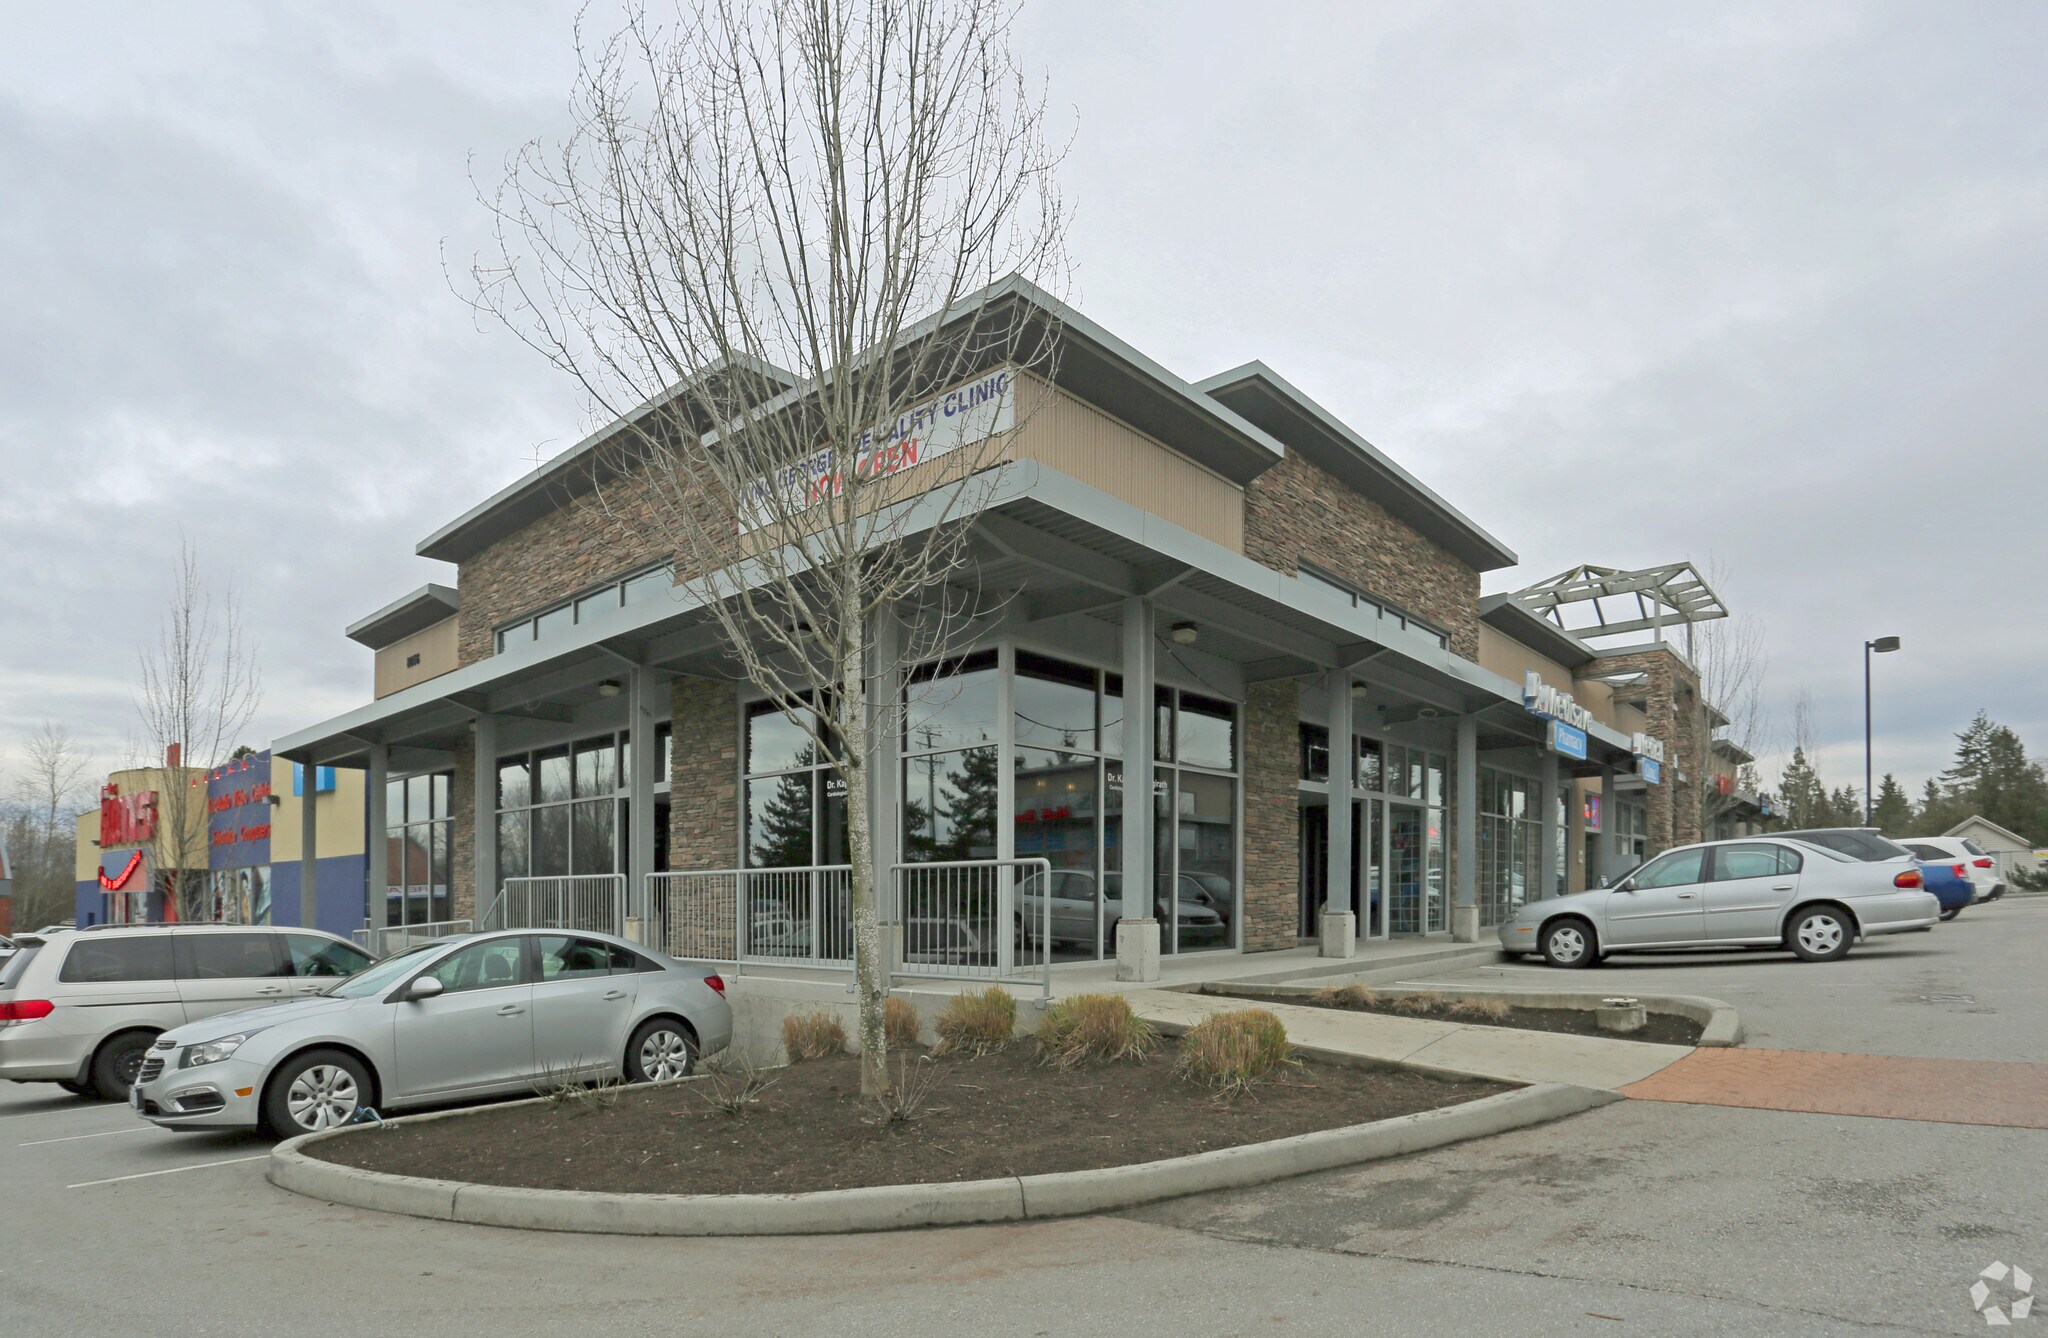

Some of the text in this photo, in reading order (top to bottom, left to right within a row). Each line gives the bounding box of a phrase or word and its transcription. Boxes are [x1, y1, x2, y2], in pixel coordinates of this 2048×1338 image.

[943, 372, 1009, 418] CLINIC
[1107, 773, 1117, 783] Dr.
[827, 780, 836, 790] Dr.
